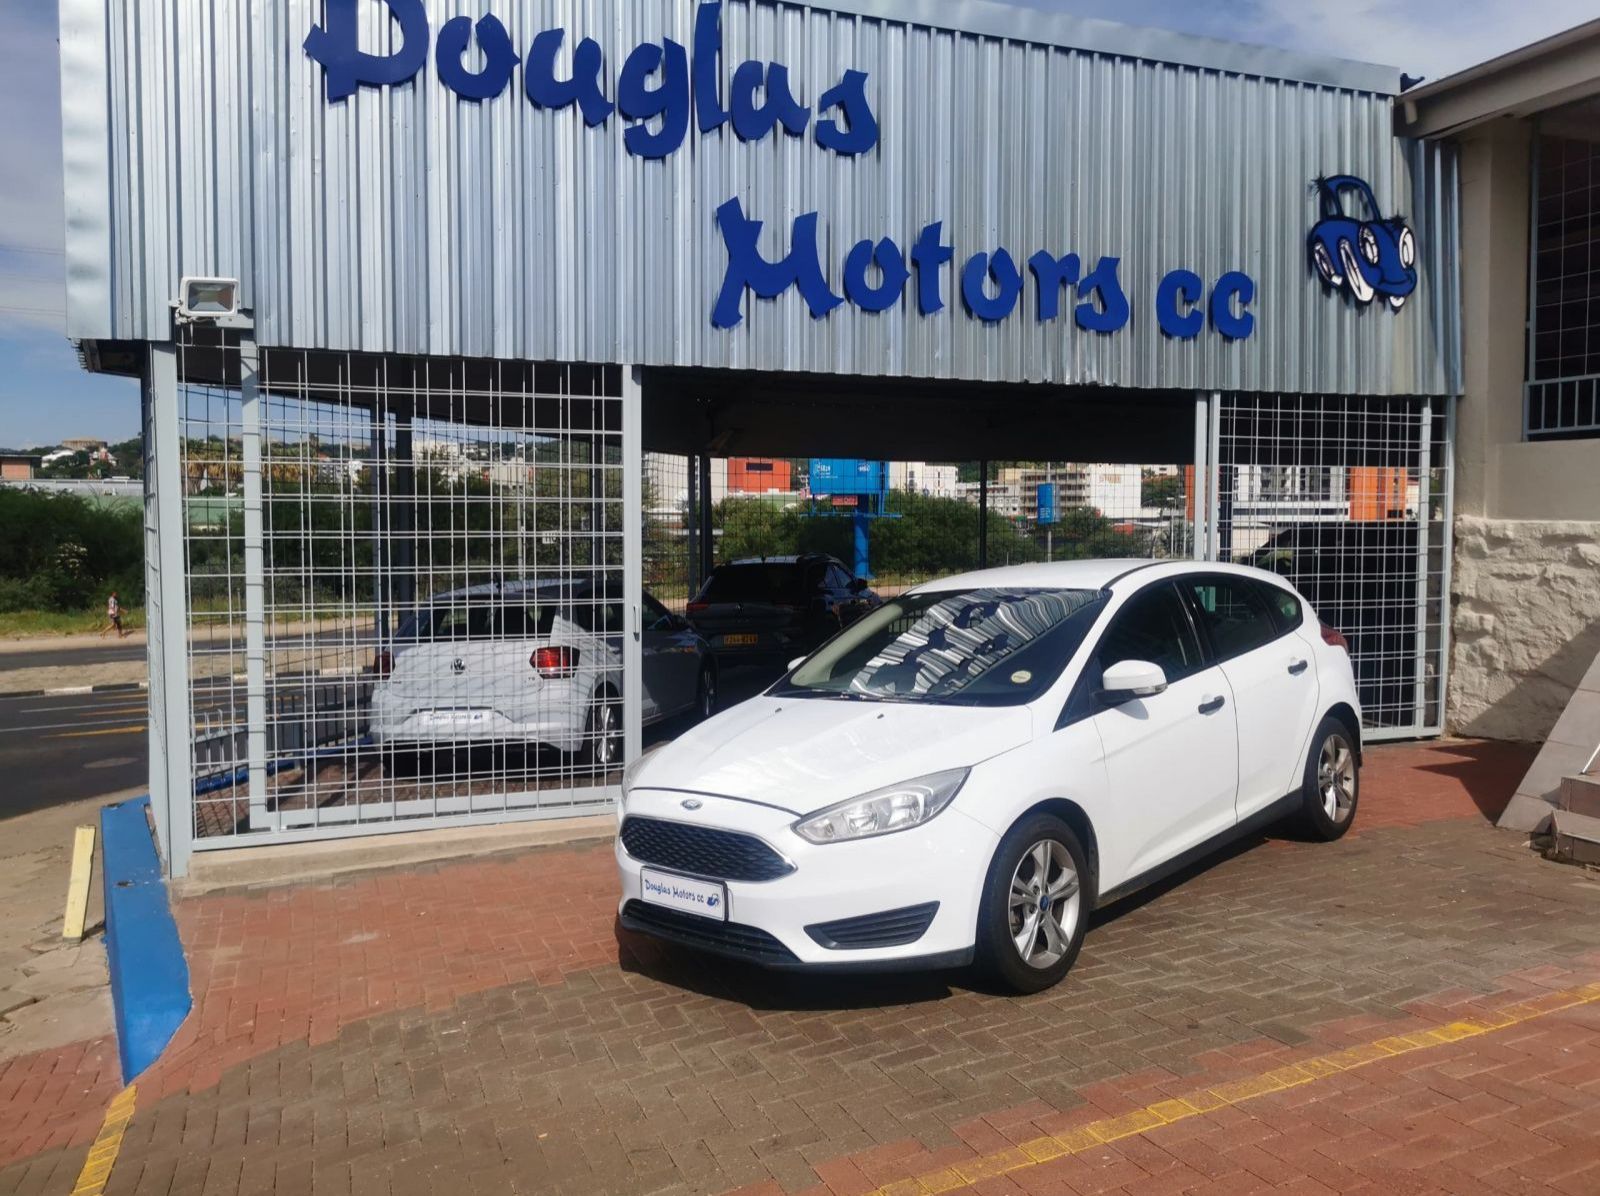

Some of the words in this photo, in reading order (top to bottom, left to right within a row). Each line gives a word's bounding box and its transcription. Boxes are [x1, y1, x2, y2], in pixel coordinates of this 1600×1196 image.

[304, 0, 880, 160] Douglas
[711, 195, 1130, 333] Motors
[1156, 268, 1255, 341] cc
[645, 879, 671, 895] Douglas
[672, 885, 696, 902] Motors
